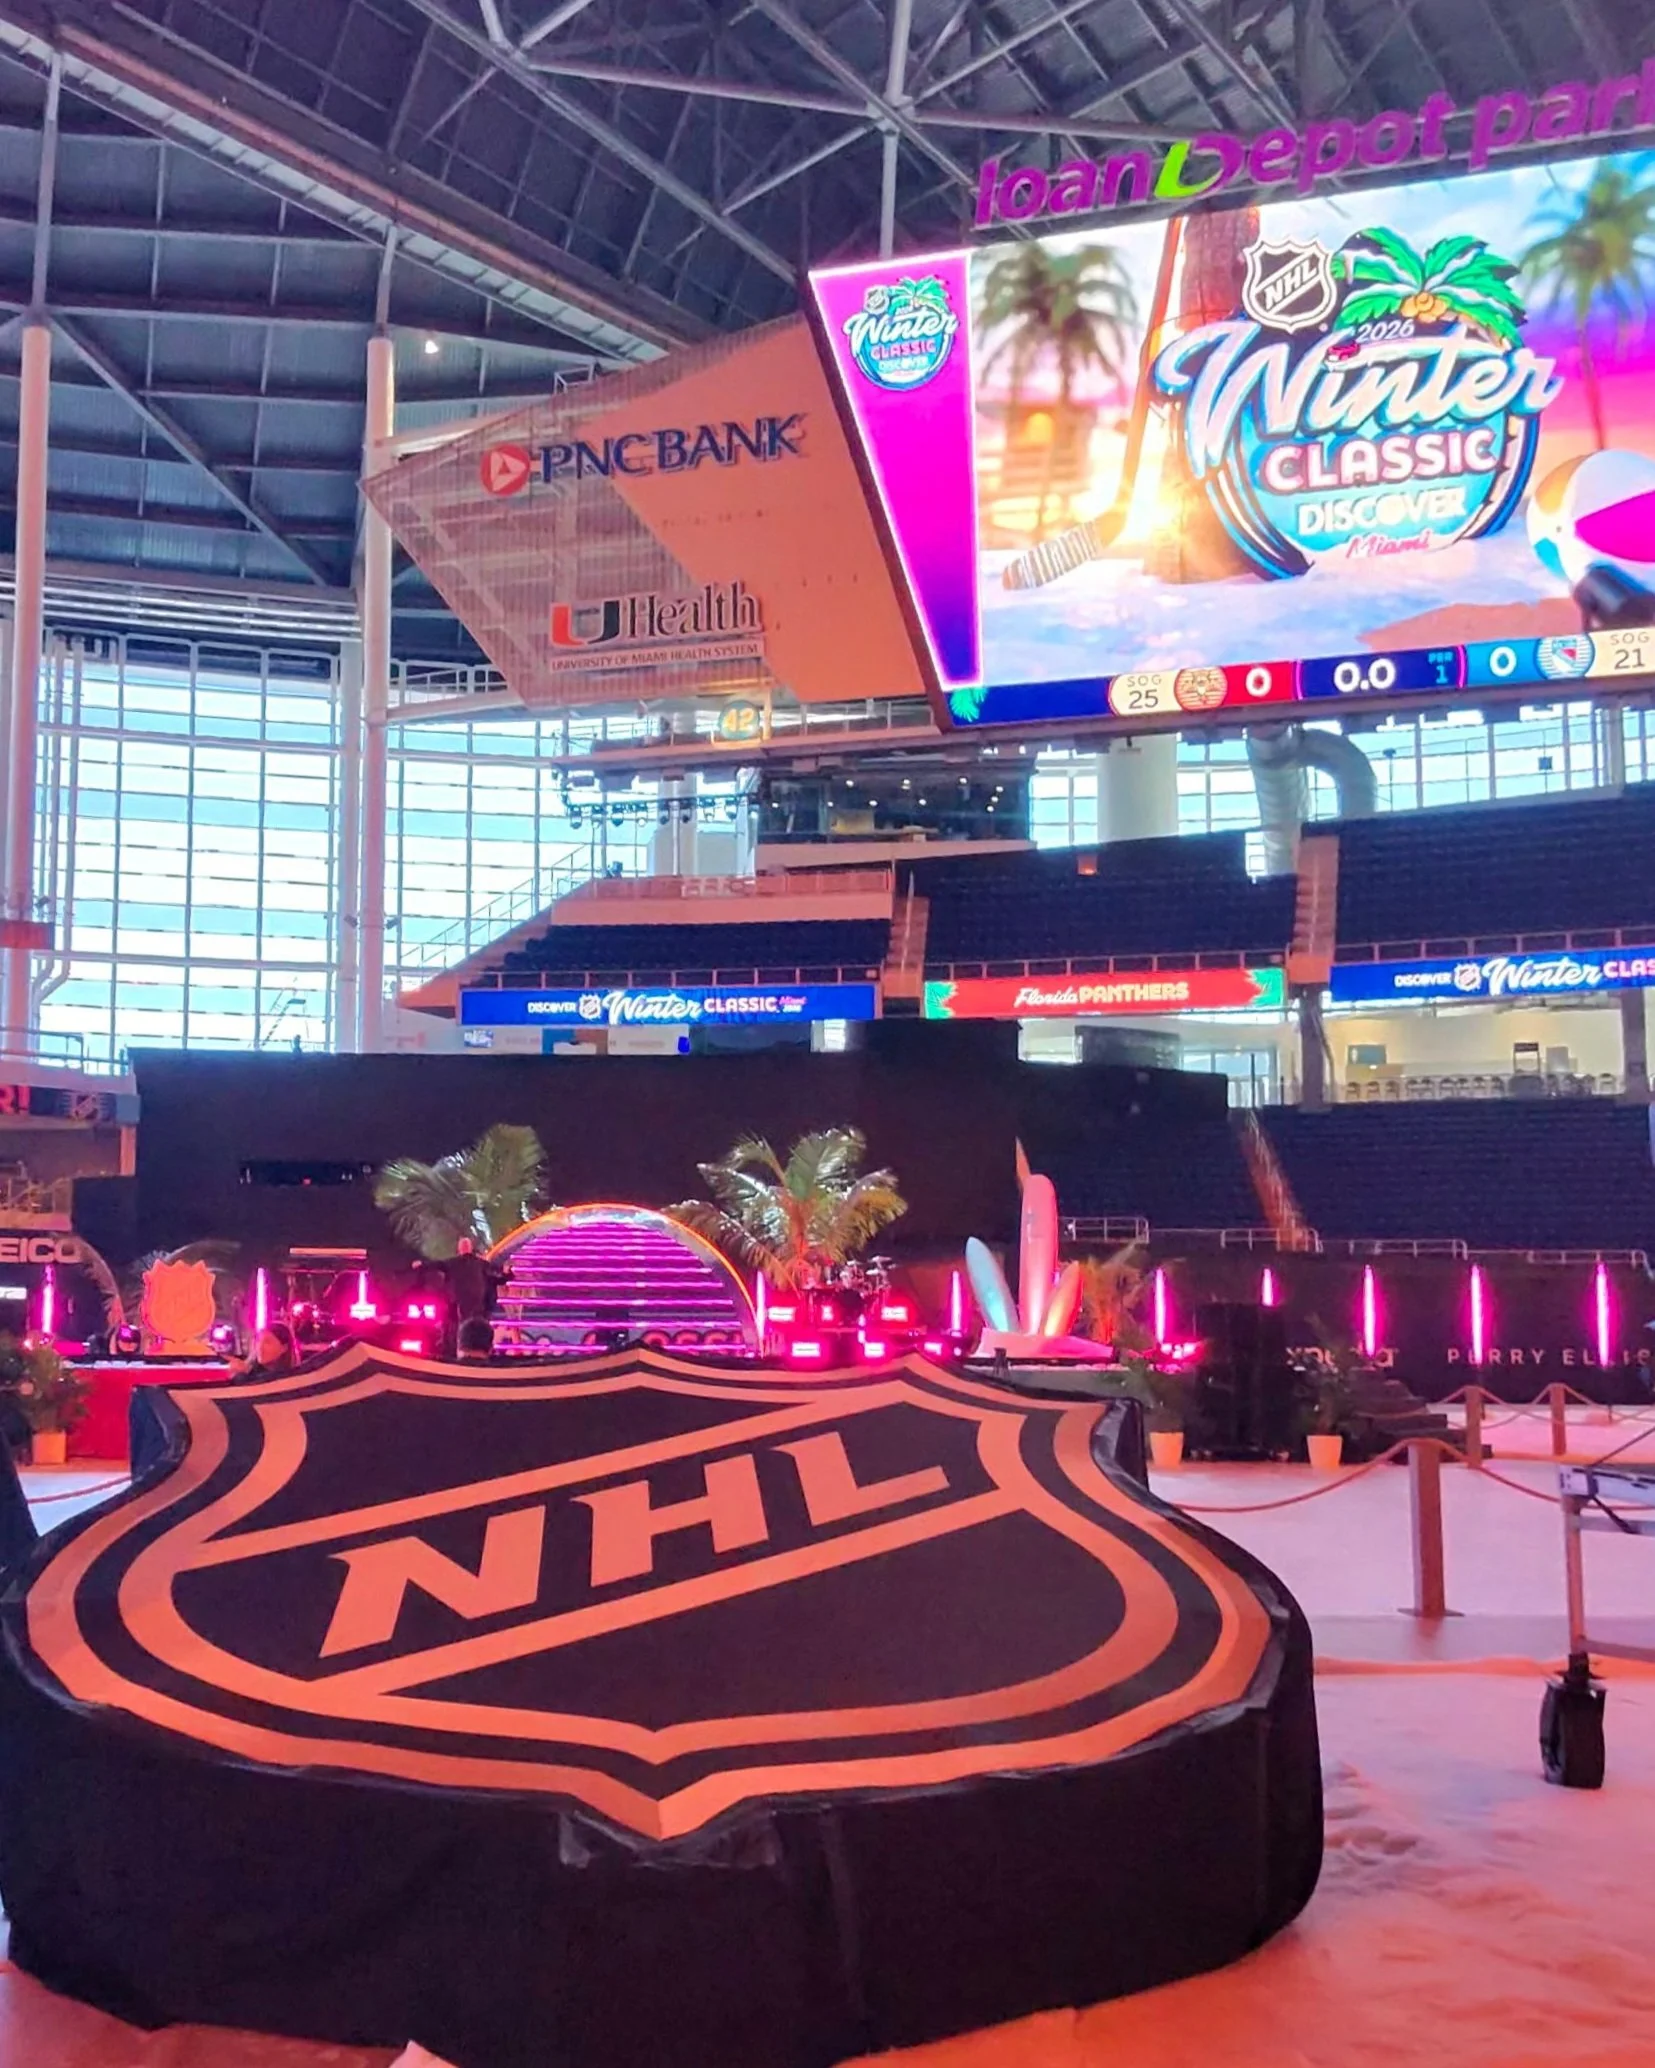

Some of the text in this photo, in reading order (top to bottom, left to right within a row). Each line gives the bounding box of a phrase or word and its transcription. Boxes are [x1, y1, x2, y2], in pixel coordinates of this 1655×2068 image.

[974, 91, 1456, 228] loanDepot
[1263, 256, 1318, 309] NHL
[842, 307, 960, 358] Winter
[1357, 319, 1415, 344] 2026
[871, 339, 936, 360] CLASSIC
[1154, 319, 1565, 478] Winter
[1263, 428, 1497, 493] CLASSIC
[1299, 488, 1467, 536] DISCOVER
[1346, 530, 1430, 559] Miami
[1610, 631, 1651, 646] SOG
[551, 643, 759, 672] UNIVERSITY OF MIAMI HEALTH SYSTEM
[1489, 646, 1517, 677] 0
[1614, 647, 1646, 670] 21
[1127, 675, 1162, 688] SOG
[1245, 667, 1273, 698] 0
[1333, 657, 1397, 693] 0.0
[1435, 665, 1449, 684] 1
[1128, 689, 1159, 710] 25
[723, 707, 756, 733] 42
[1481, 956, 1602, 996] Winter
[602, 989, 702, 1025] Winter
[703, 996, 778, 1014] CLASSIC
[1013, 981, 1190, 1009] Florida PANTHERS
[319, 1431, 949, 1659] NHL
